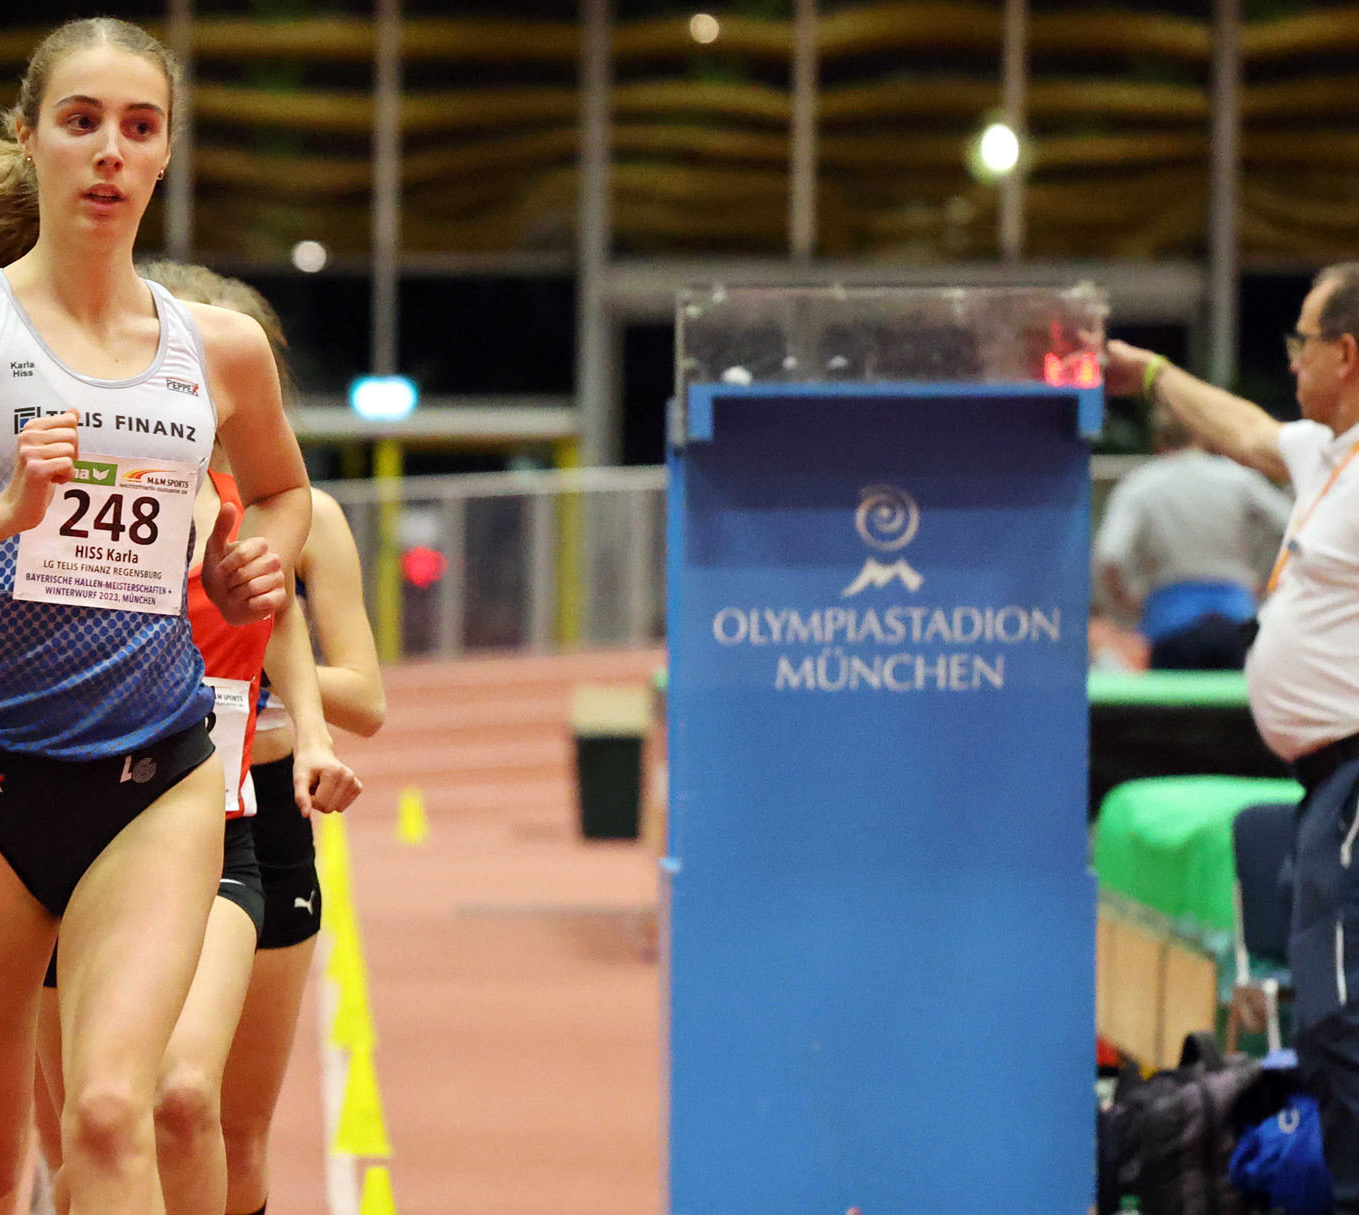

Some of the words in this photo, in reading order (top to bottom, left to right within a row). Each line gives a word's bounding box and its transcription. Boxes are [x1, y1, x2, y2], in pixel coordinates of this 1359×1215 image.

[10, 361, 35, 369] Karla
[12, 369, 33, 377] Hiss
[115, 415, 196, 442] FINANZ
[59, 488, 160, 546] 248
[75, 545, 103, 560] HISS
[106, 548, 139, 563] Karla
[43, 560, 54, 569] LG
[57, 561, 78, 571] TELIS
[80, 563, 111, 574] FINANZ
[113, 567, 162, 580] REGENSBURG
[25, 573, 73, 585] BAYERISCHE
[74, 578, 167, 595] HALLEN-MEISTERSCHAFTEN
[45, 586, 98, 599] WINTERWURF
[99, 591, 121, 603] 2023,
[122, 592, 156, 605] MÜNCHEN
[713, 607, 1061, 645] OLYMPIASTADION
[775, 648, 1005, 691] MÜNCHEN
